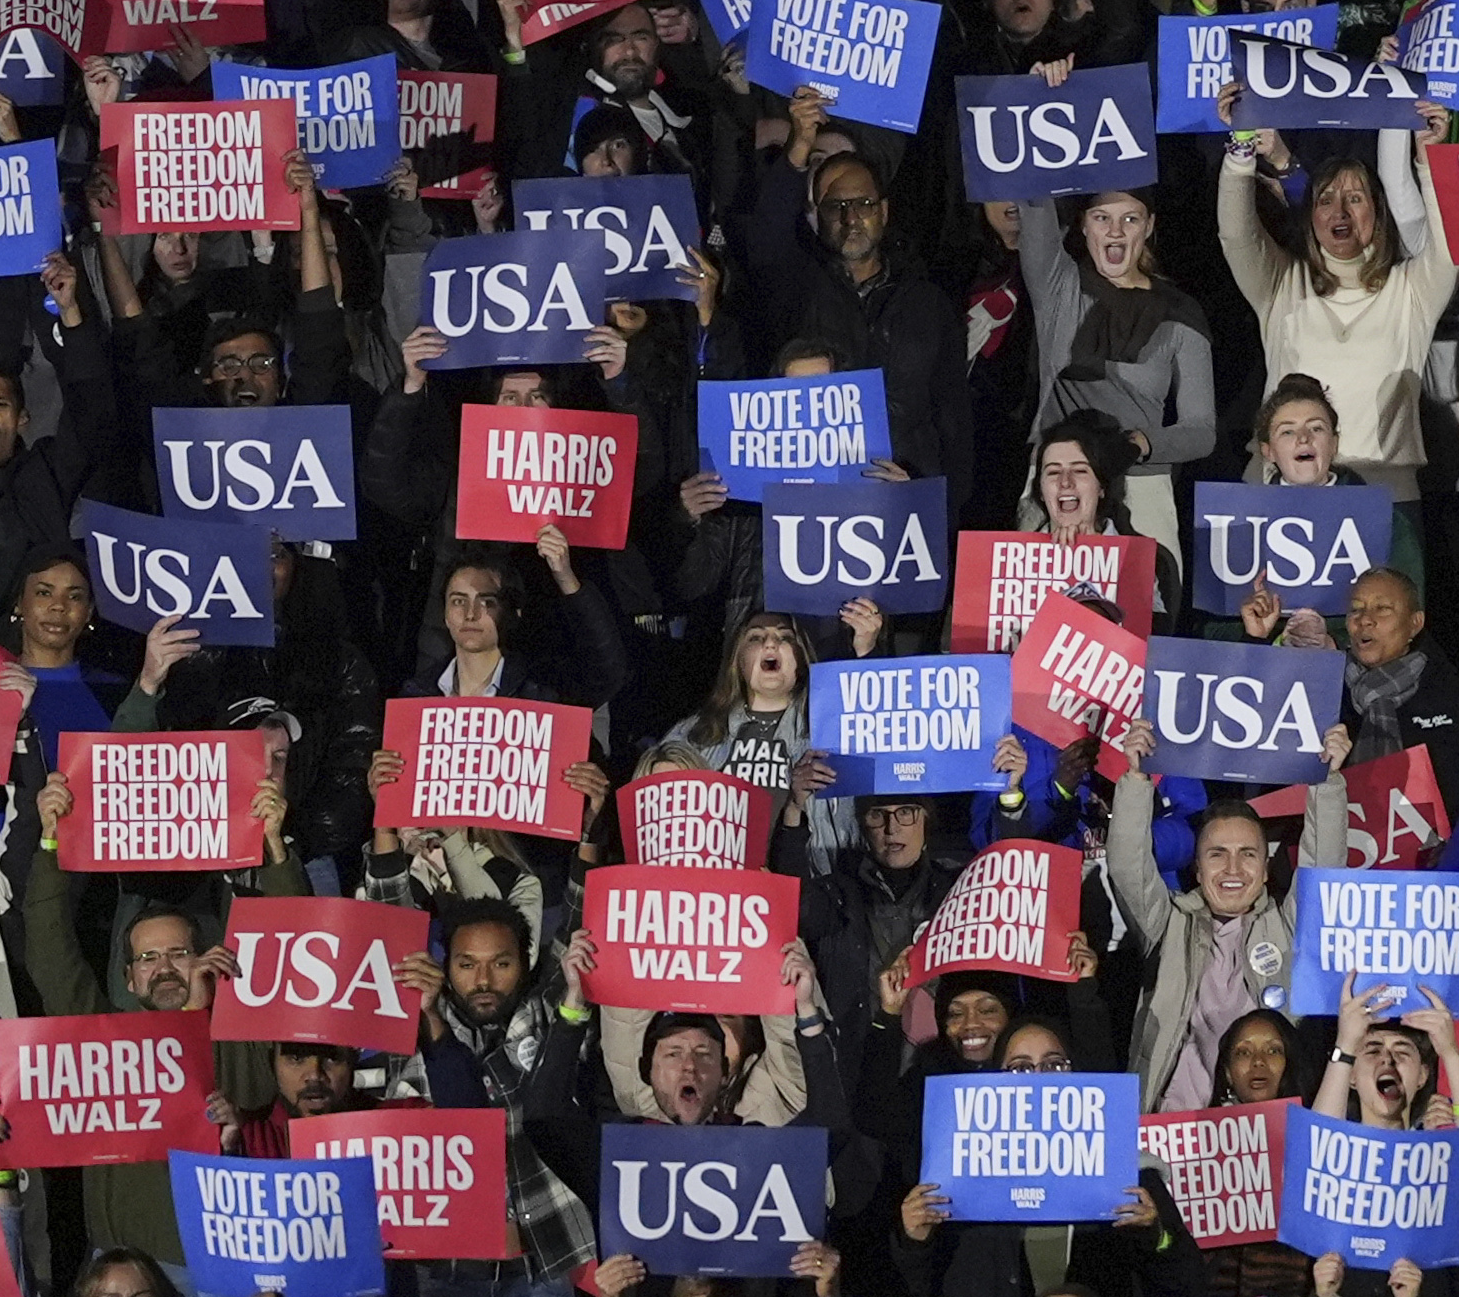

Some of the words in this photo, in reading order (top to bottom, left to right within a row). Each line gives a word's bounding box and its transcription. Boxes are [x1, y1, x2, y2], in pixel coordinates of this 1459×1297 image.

[1241, 40, 1418, 98] USA
[431, 262, 594, 336] USA
[840, 669, 912, 712] VOTE
[921, 667, 979, 708] FOR
[1154, 671, 1324, 752] USA
[841, 709, 980, 754] FREEDOM
[893, 762, 926, 775] HARRIS
[19, 1038, 184, 1100] HARRIS
[45, 1099, 161, 1134] WALZ
[1311, 1125, 1385, 1183] VOTE
[1391, 1142, 1450, 1185] FOR
[613, 1161, 813, 1241] USA
[1304, 1169, 1446, 1228] FREEDOM
